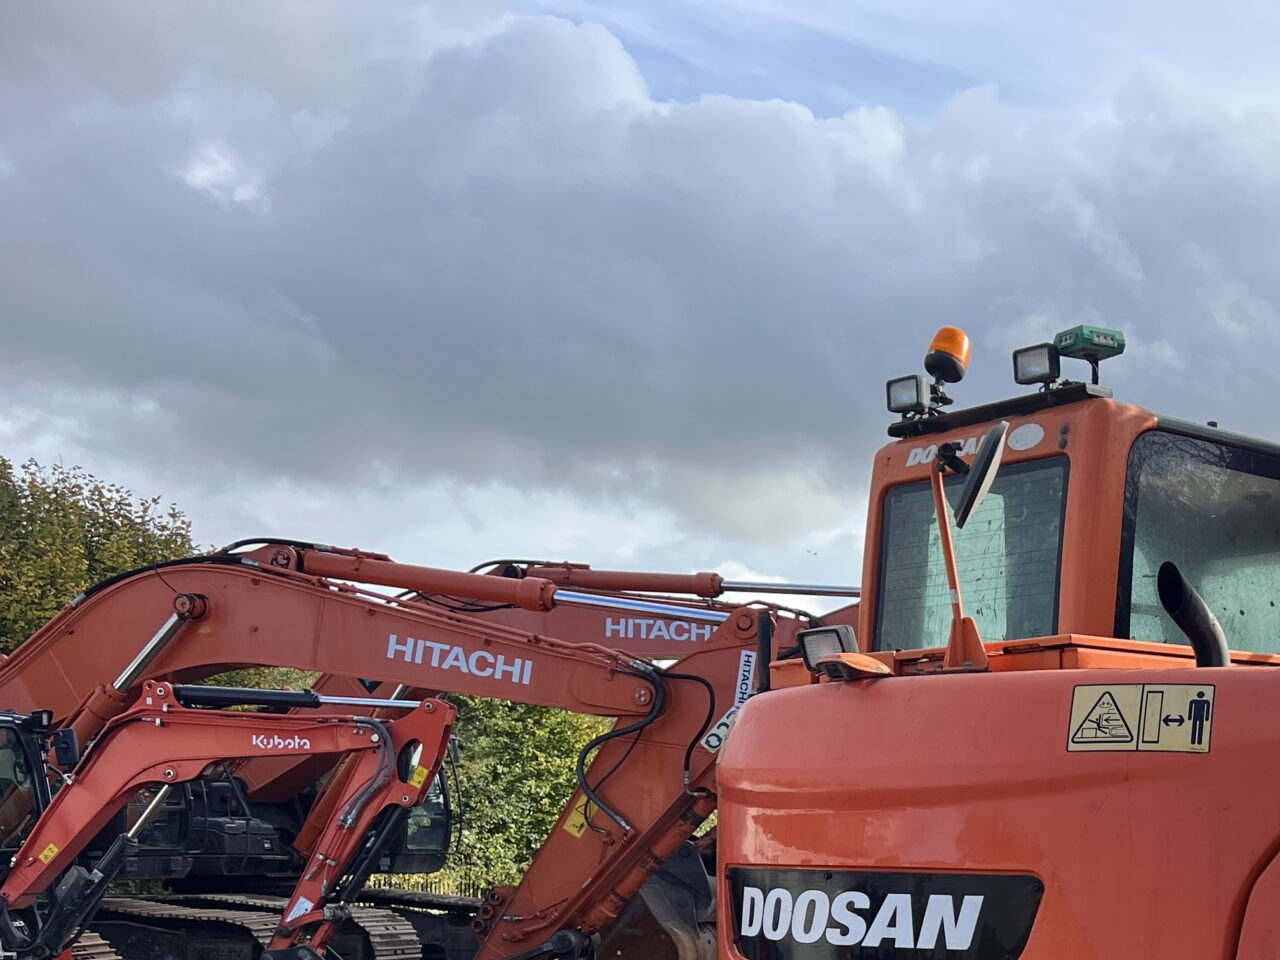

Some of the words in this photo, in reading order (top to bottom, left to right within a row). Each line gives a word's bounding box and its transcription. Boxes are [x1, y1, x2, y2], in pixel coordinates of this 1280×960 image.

[387, 634, 533, 685] HITACHI
[737, 654, 753, 704] HITACHI
[252, 734, 311, 750] Kubota
[740, 886, 984, 950] DOOSAN
